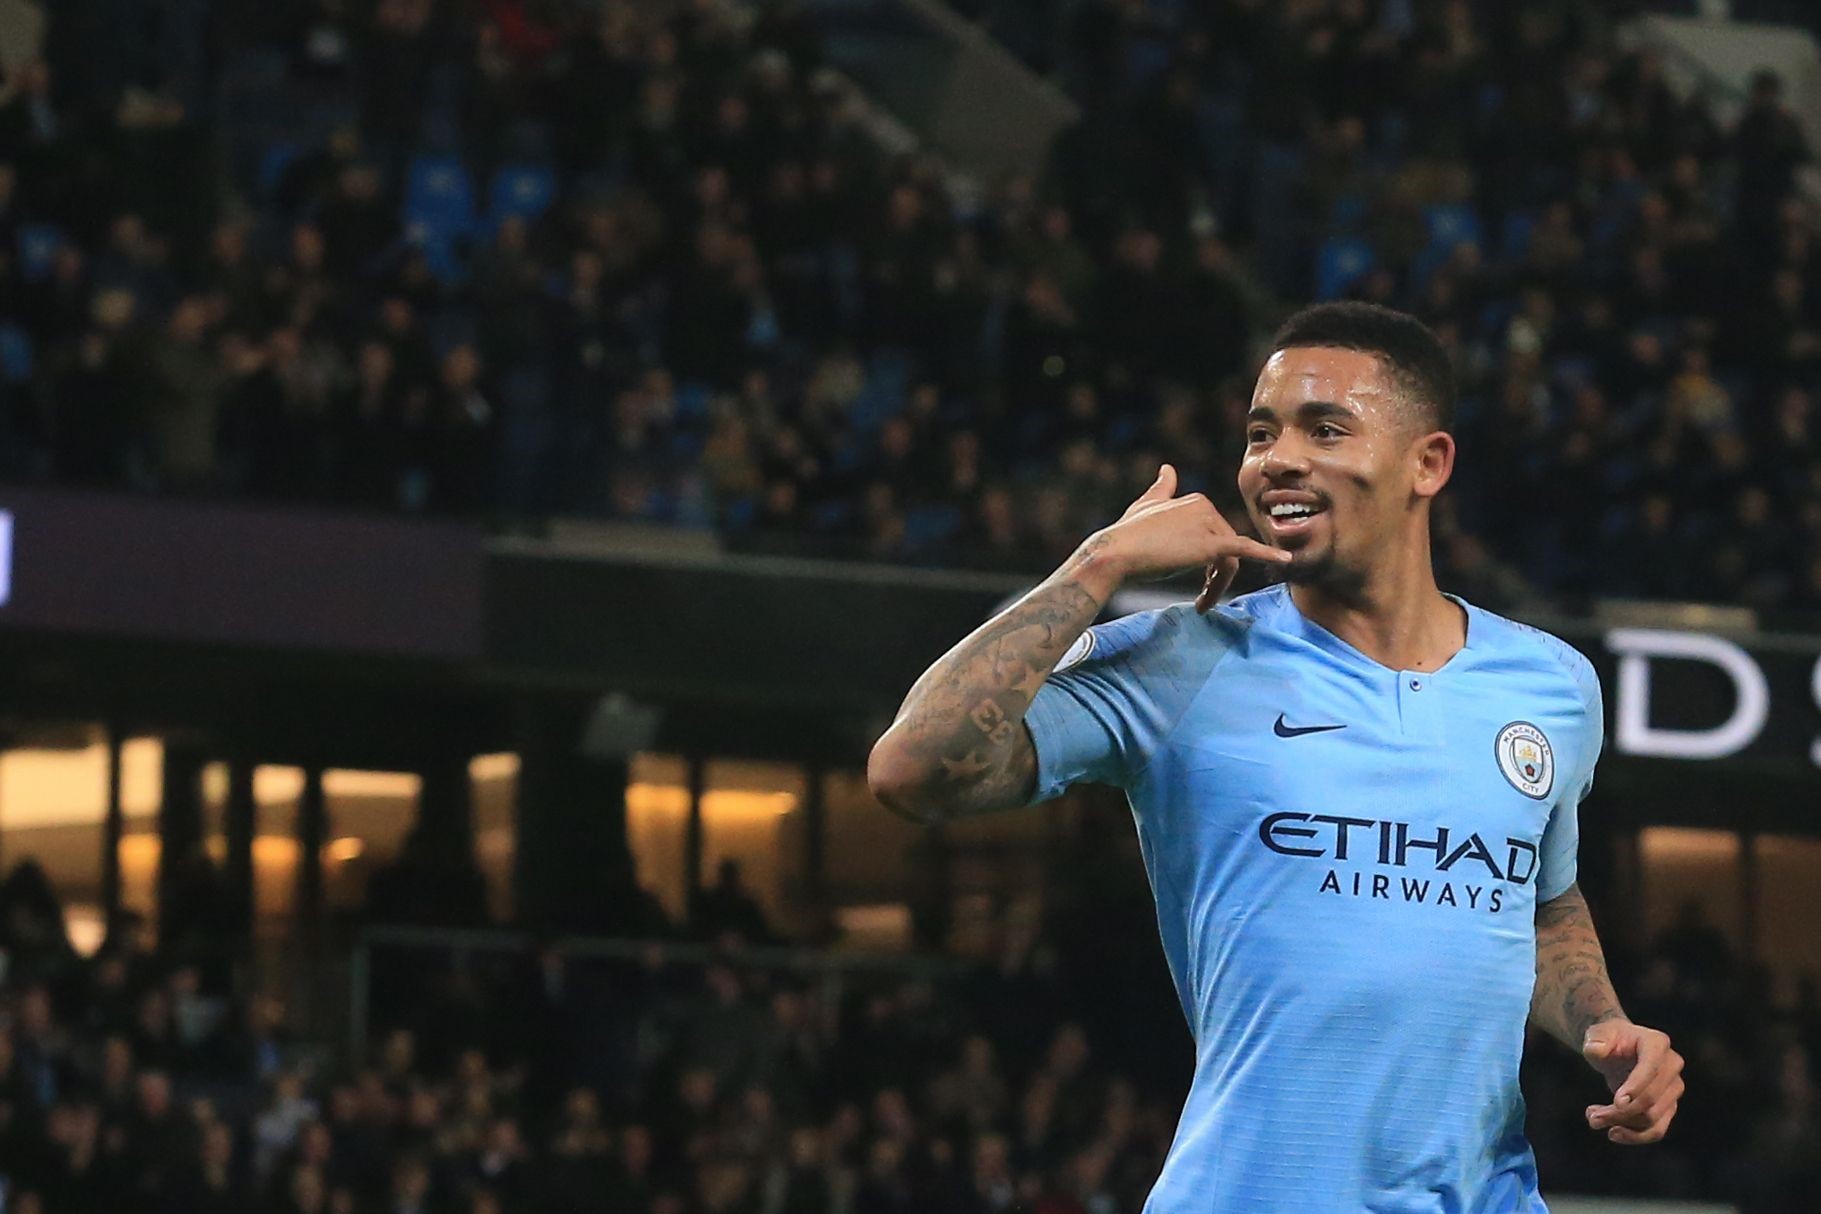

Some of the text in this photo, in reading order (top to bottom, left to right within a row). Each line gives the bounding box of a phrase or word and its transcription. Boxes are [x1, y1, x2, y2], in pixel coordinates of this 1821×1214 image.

[1604, 627, 1771, 761] D
[1520, 782, 1541, 794] CITY
[1258, 811, 1537, 886] ETIHAD
[1319, 868, 1504, 914] AIRWAYS
